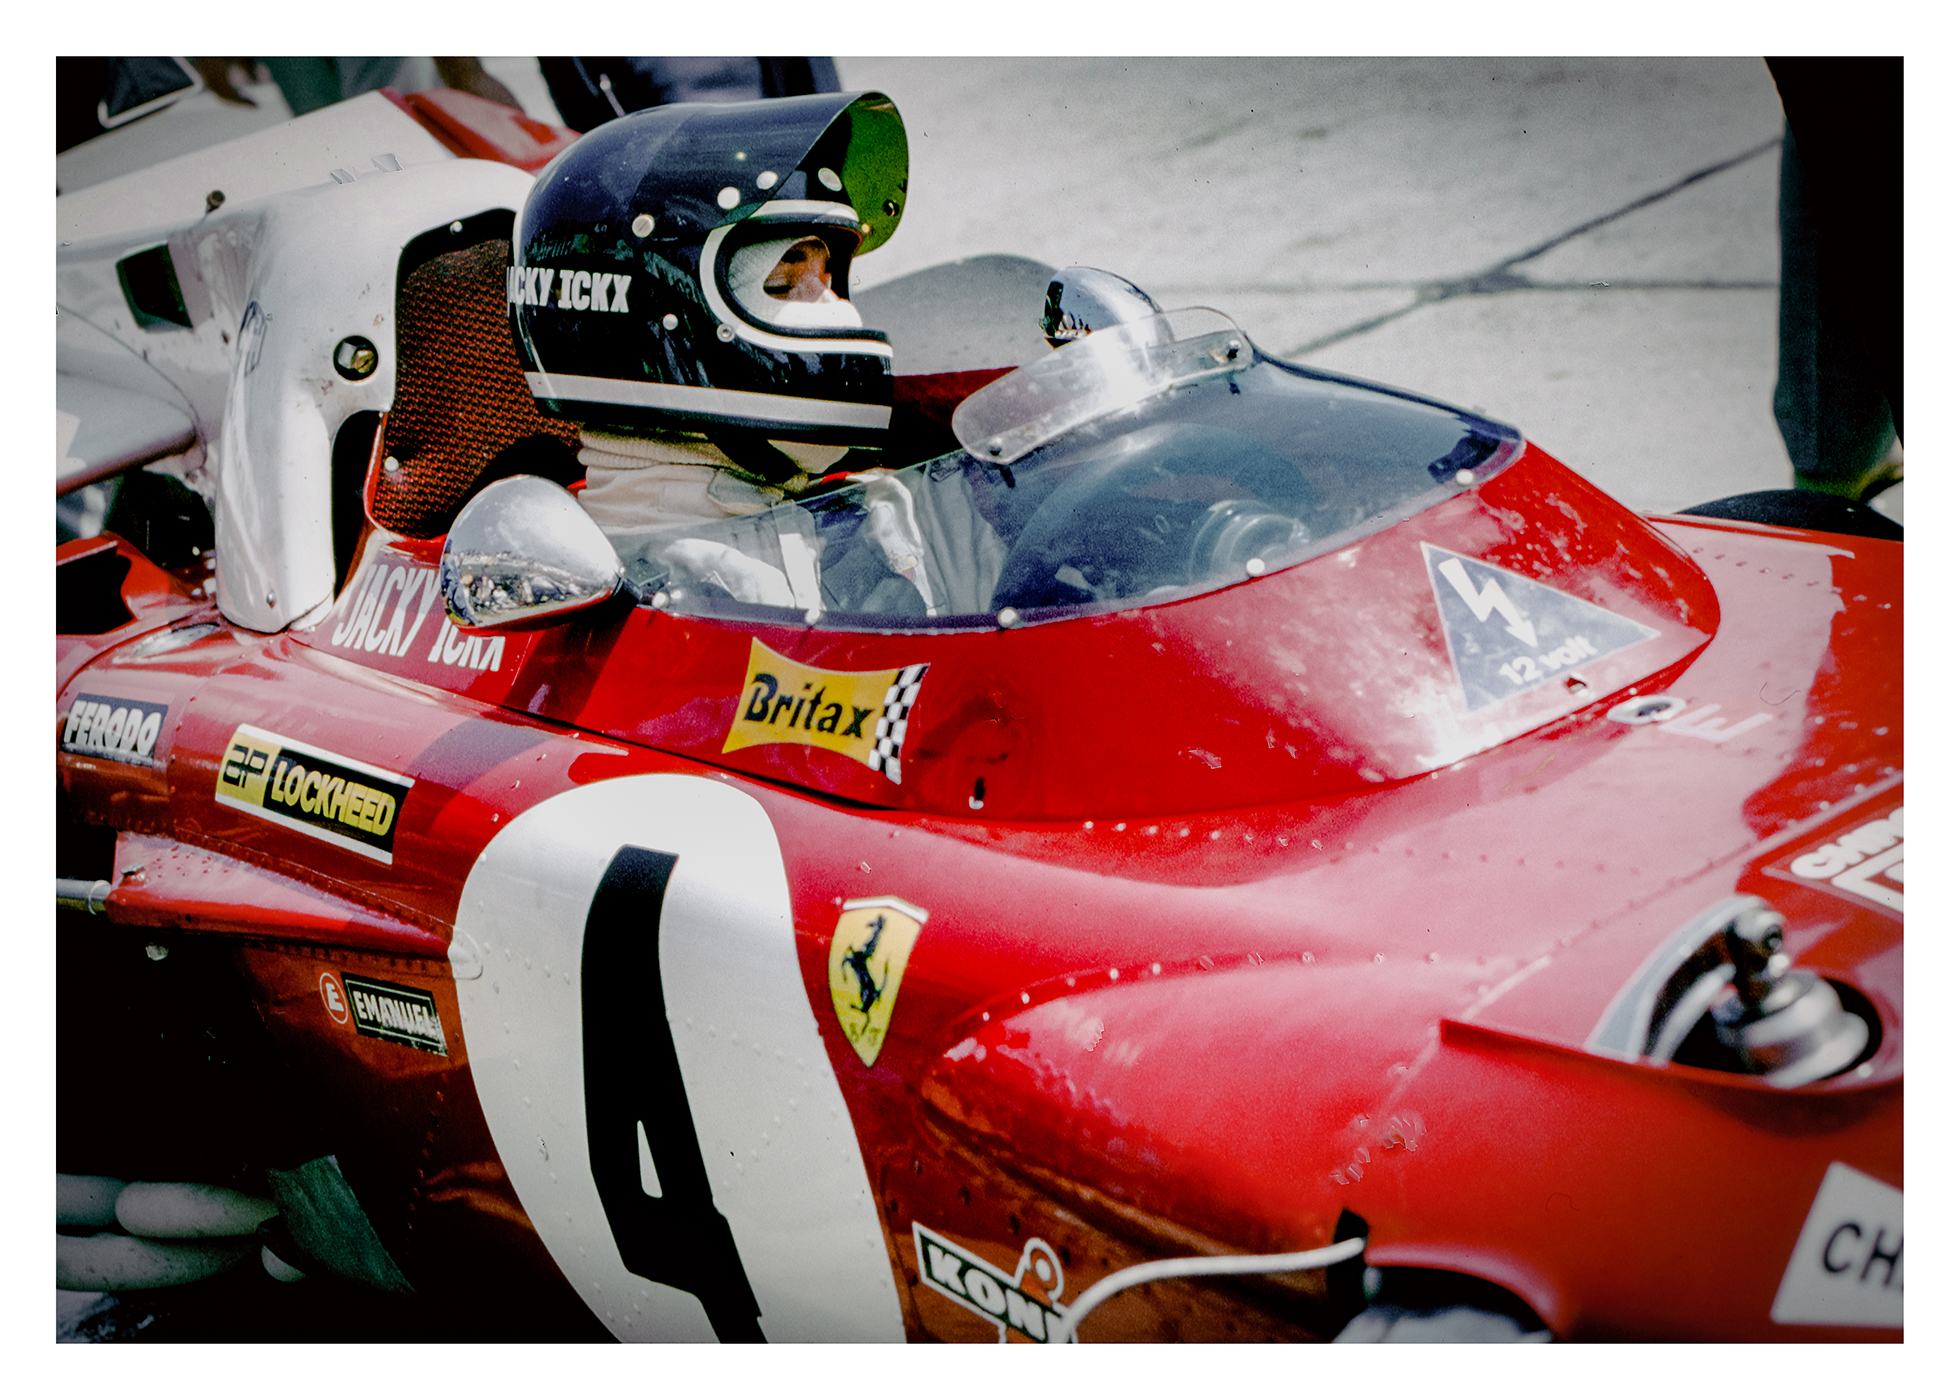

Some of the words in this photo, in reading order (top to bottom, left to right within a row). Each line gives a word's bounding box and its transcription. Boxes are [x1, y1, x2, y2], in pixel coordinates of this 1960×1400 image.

[507, 265, 554, 307] ACKY
[558, 269, 632, 313] ICKX
[332, 564, 441, 658] JACKY
[1500, 656, 1542, 685] 12
[1538, 635, 1598, 670] volt
[64, 700, 161, 756] FERODO
[744, 673, 875, 739] Britax
[271, 760, 396, 836] LOCKHEED
[325, 982, 344, 1012] E
[353, 990, 440, 1042] EMANUEL
[581, 845, 768, 1344] 4
